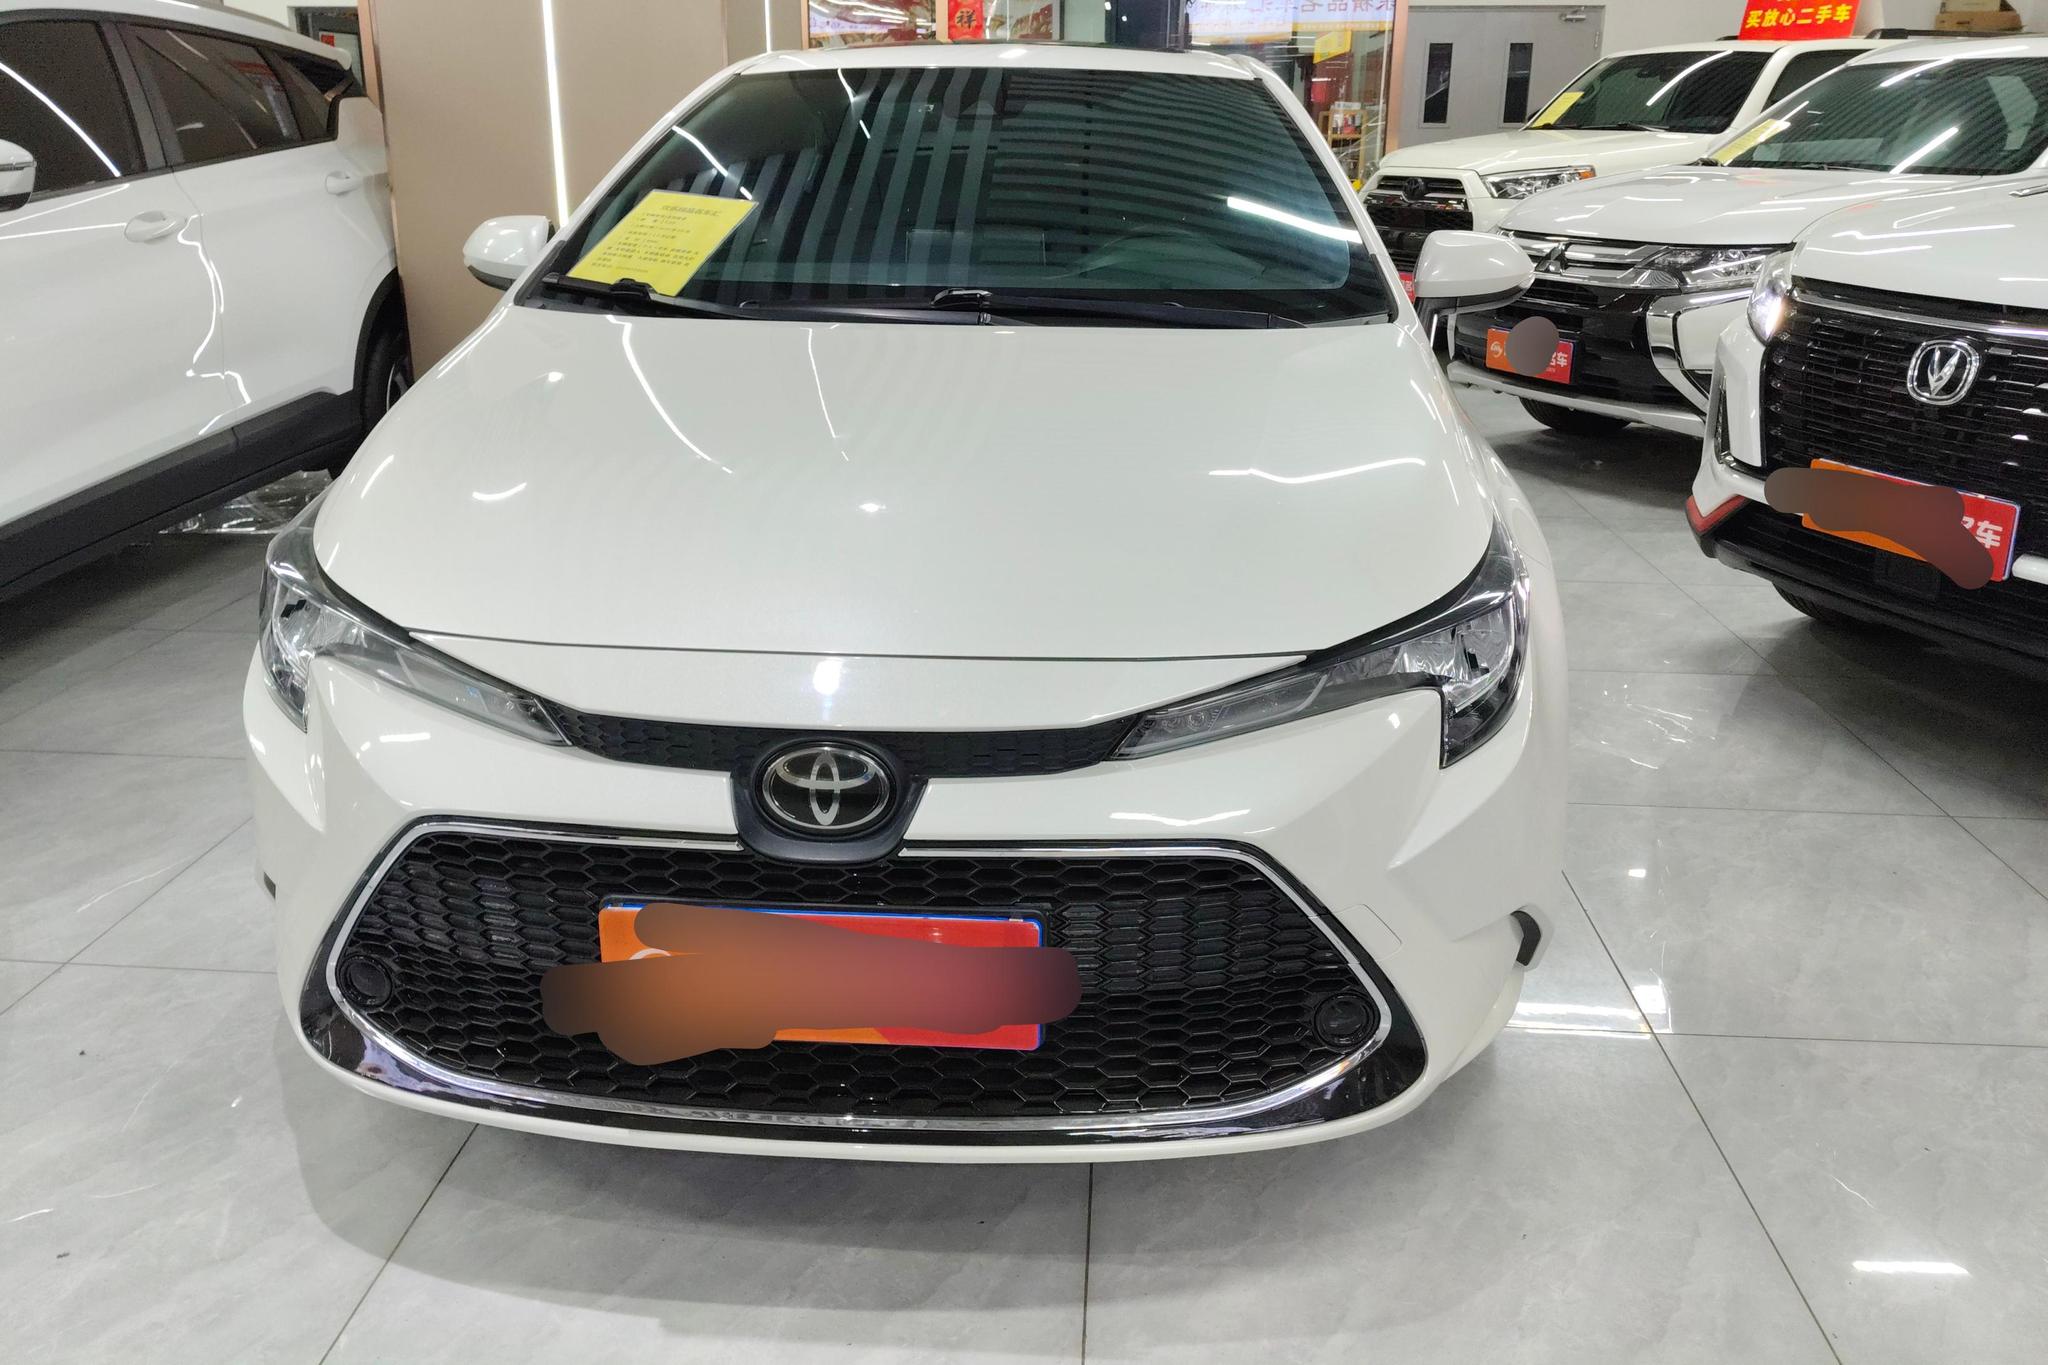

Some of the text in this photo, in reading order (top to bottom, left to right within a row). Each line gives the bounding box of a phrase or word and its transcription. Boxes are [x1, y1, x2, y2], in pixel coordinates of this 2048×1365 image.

[1745, 4, 1852, 28] 买放心二手车
